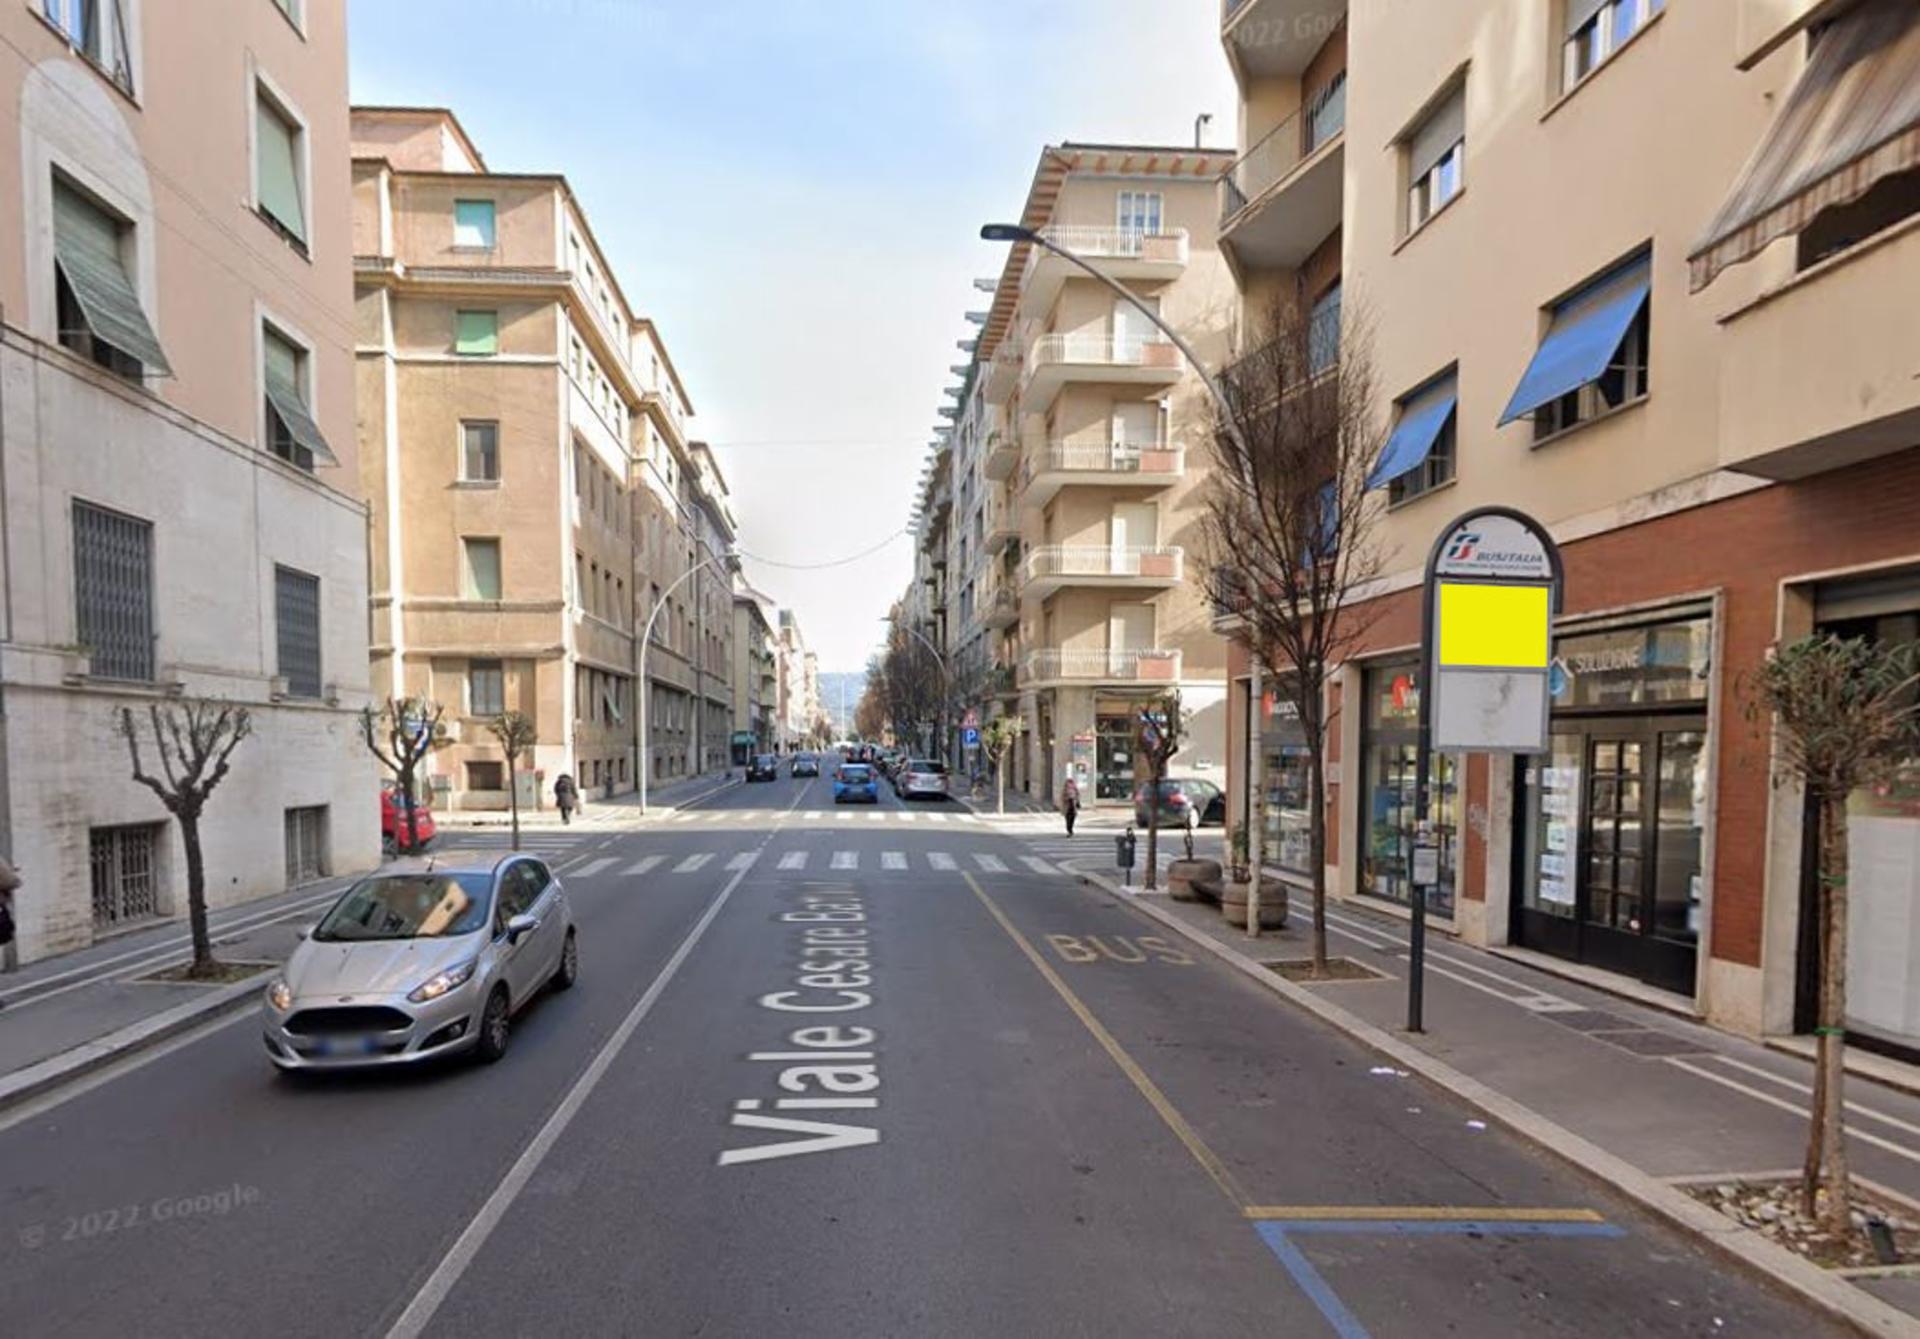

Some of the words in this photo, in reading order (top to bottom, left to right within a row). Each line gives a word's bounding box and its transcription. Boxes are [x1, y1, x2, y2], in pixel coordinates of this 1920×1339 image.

[1476, 551, 1543, 563] BUSITALIA
[966, 729, 977, 743] P
[1044, 933, 1198, 966] BUS
